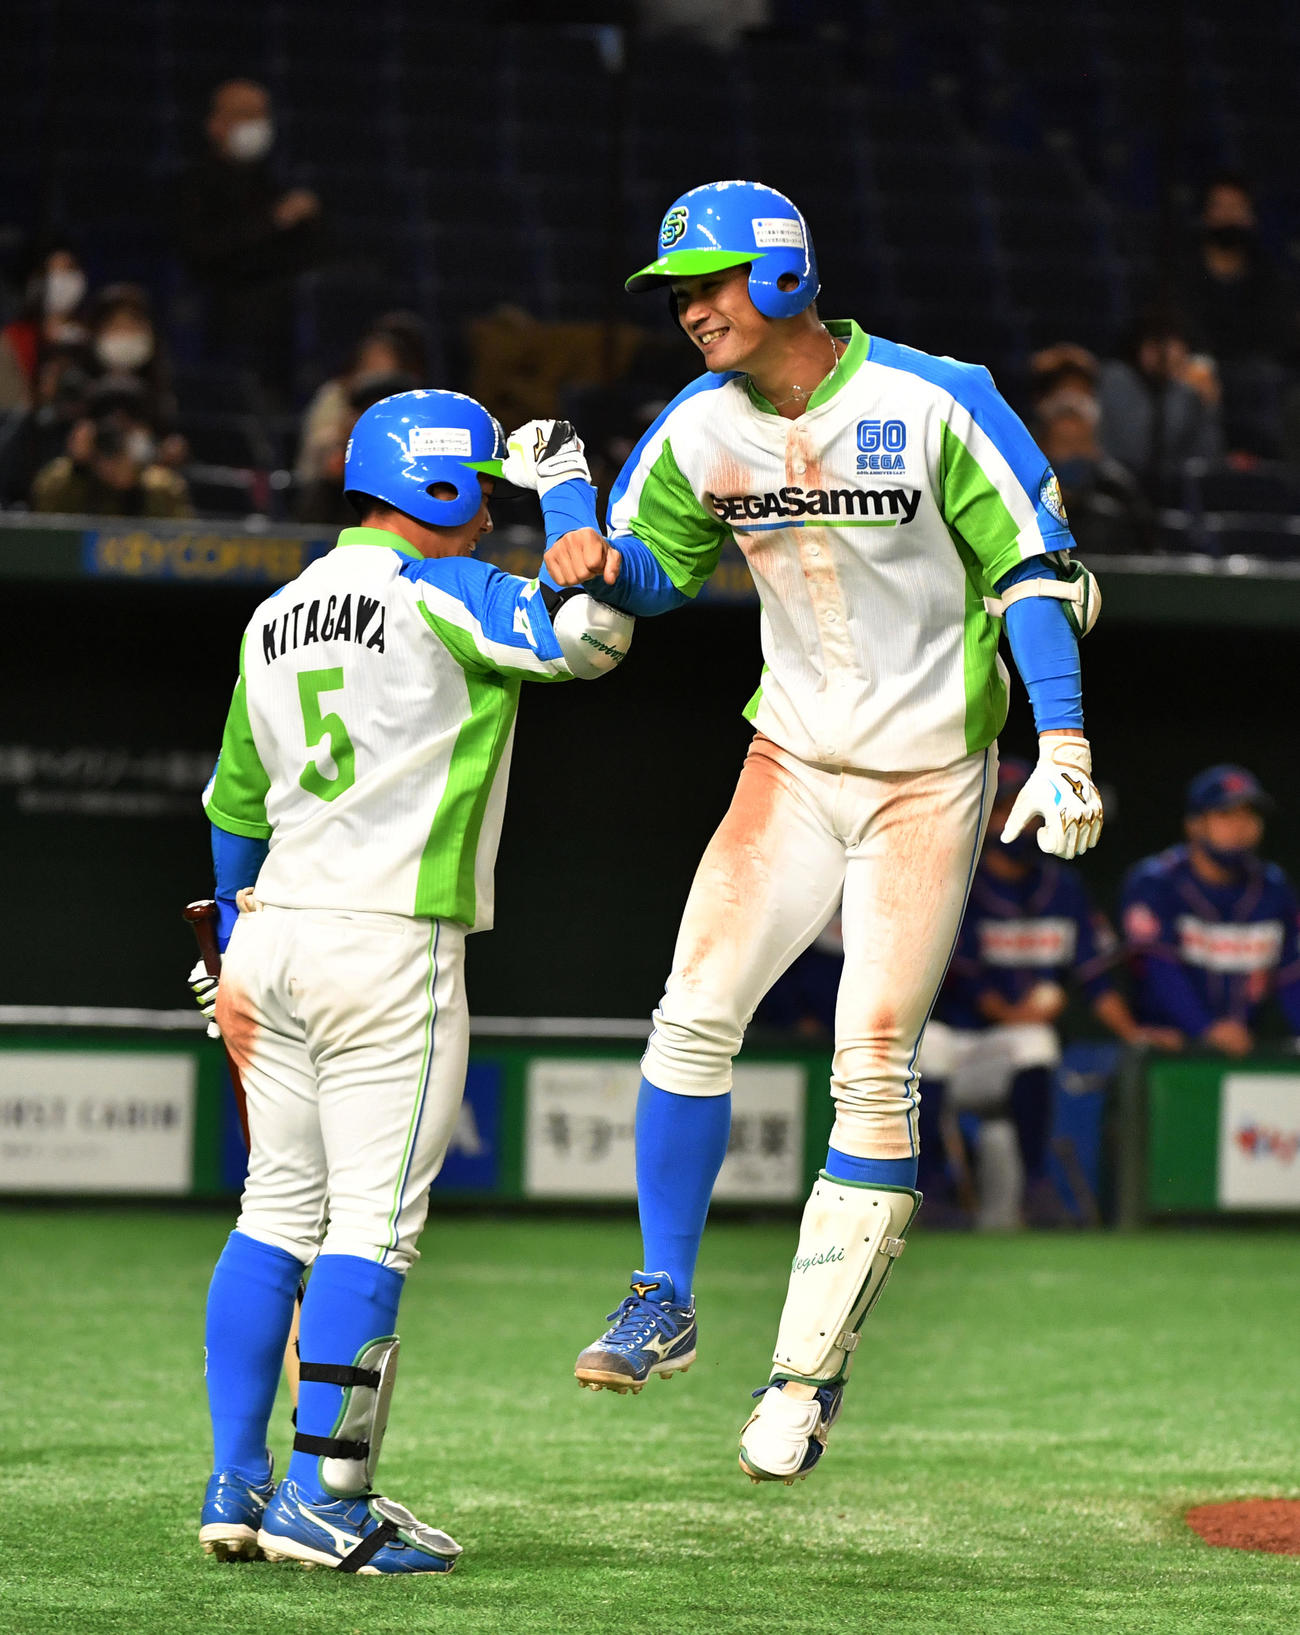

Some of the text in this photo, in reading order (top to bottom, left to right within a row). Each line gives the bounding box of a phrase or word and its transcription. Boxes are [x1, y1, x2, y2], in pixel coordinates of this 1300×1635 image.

[856, 454, 905, 470] SEGA
[857, 420, 906, 452] GO
[263, 593, 386, 666] KITAGAWA
[297, 666, 355, 803] 5
